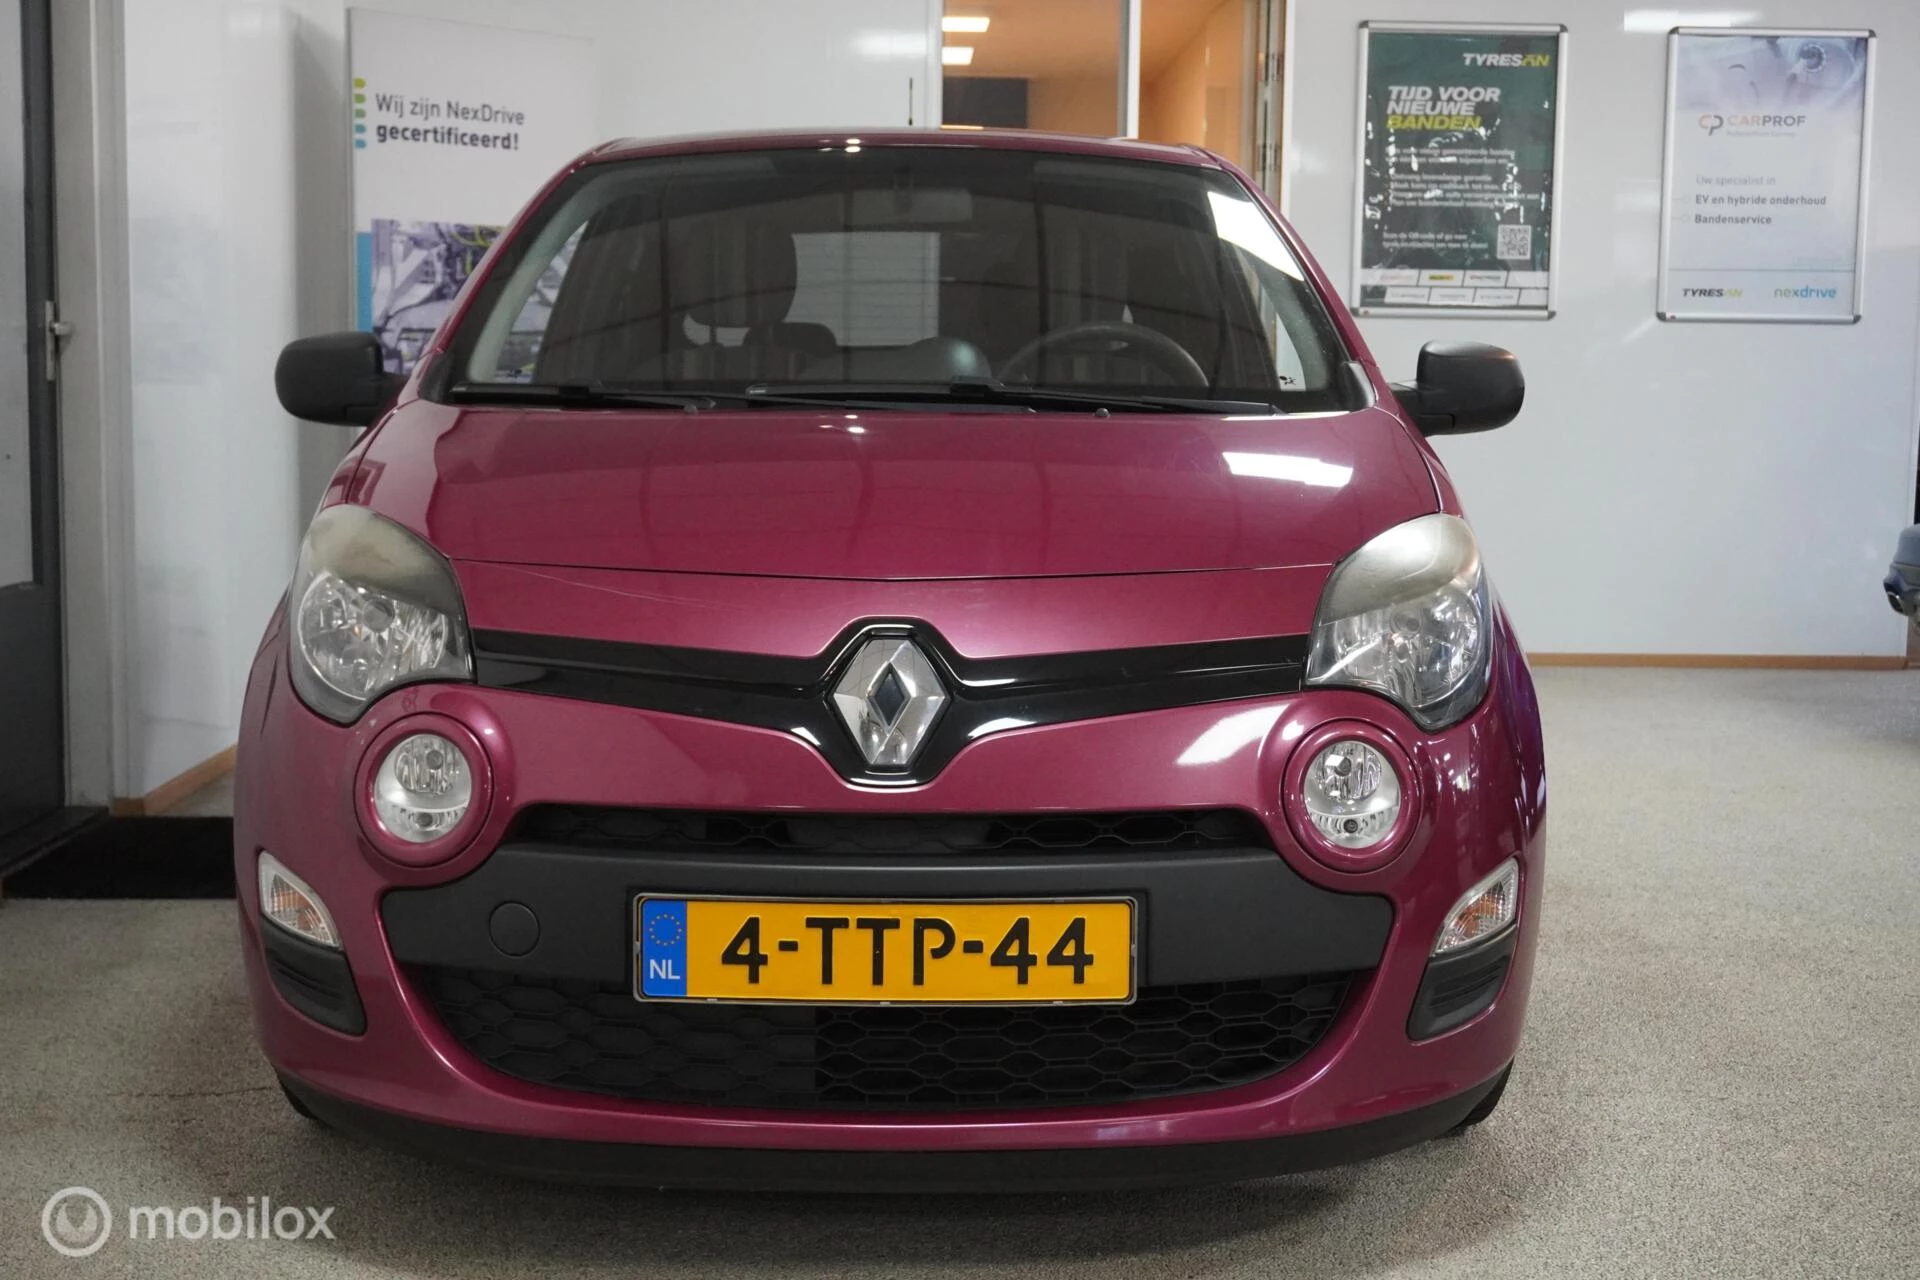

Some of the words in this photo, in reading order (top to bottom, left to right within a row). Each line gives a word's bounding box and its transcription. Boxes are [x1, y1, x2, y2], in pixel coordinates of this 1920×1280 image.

[1439, 86, 1501, 102] VOOR
[375, 93, 404, 119] Wij
[409, 97, 441, 121] zijn
[446, 100, 525, 126] NexDrive
[1386, 100, 1476, 116] NIEUWE
[1386, 115, 1481, 130] BANDEN
[1726, 114, 1806, 127] CARPROF
[376, 124, 519, 150] gecertificeerd!
[1696, 174, 1713, 185] Uw
[1715, 175, 1764, 187] specialist
[1766, 175, 1776, 185] in
[1695, 194, 1709, 205] EV
[1711, 195, 1725, 205] en
[1727, 195, 1767, 207] hybride
[1769, 196, 1827, 206] onderhoud
[1694, 214, 1772, 225] Bandenservice
[1773, 284, 1838, 299] nexdrive
[721, 916, 1094, 986] 4-TTP-44
[648, 958, 681, 980] NL
